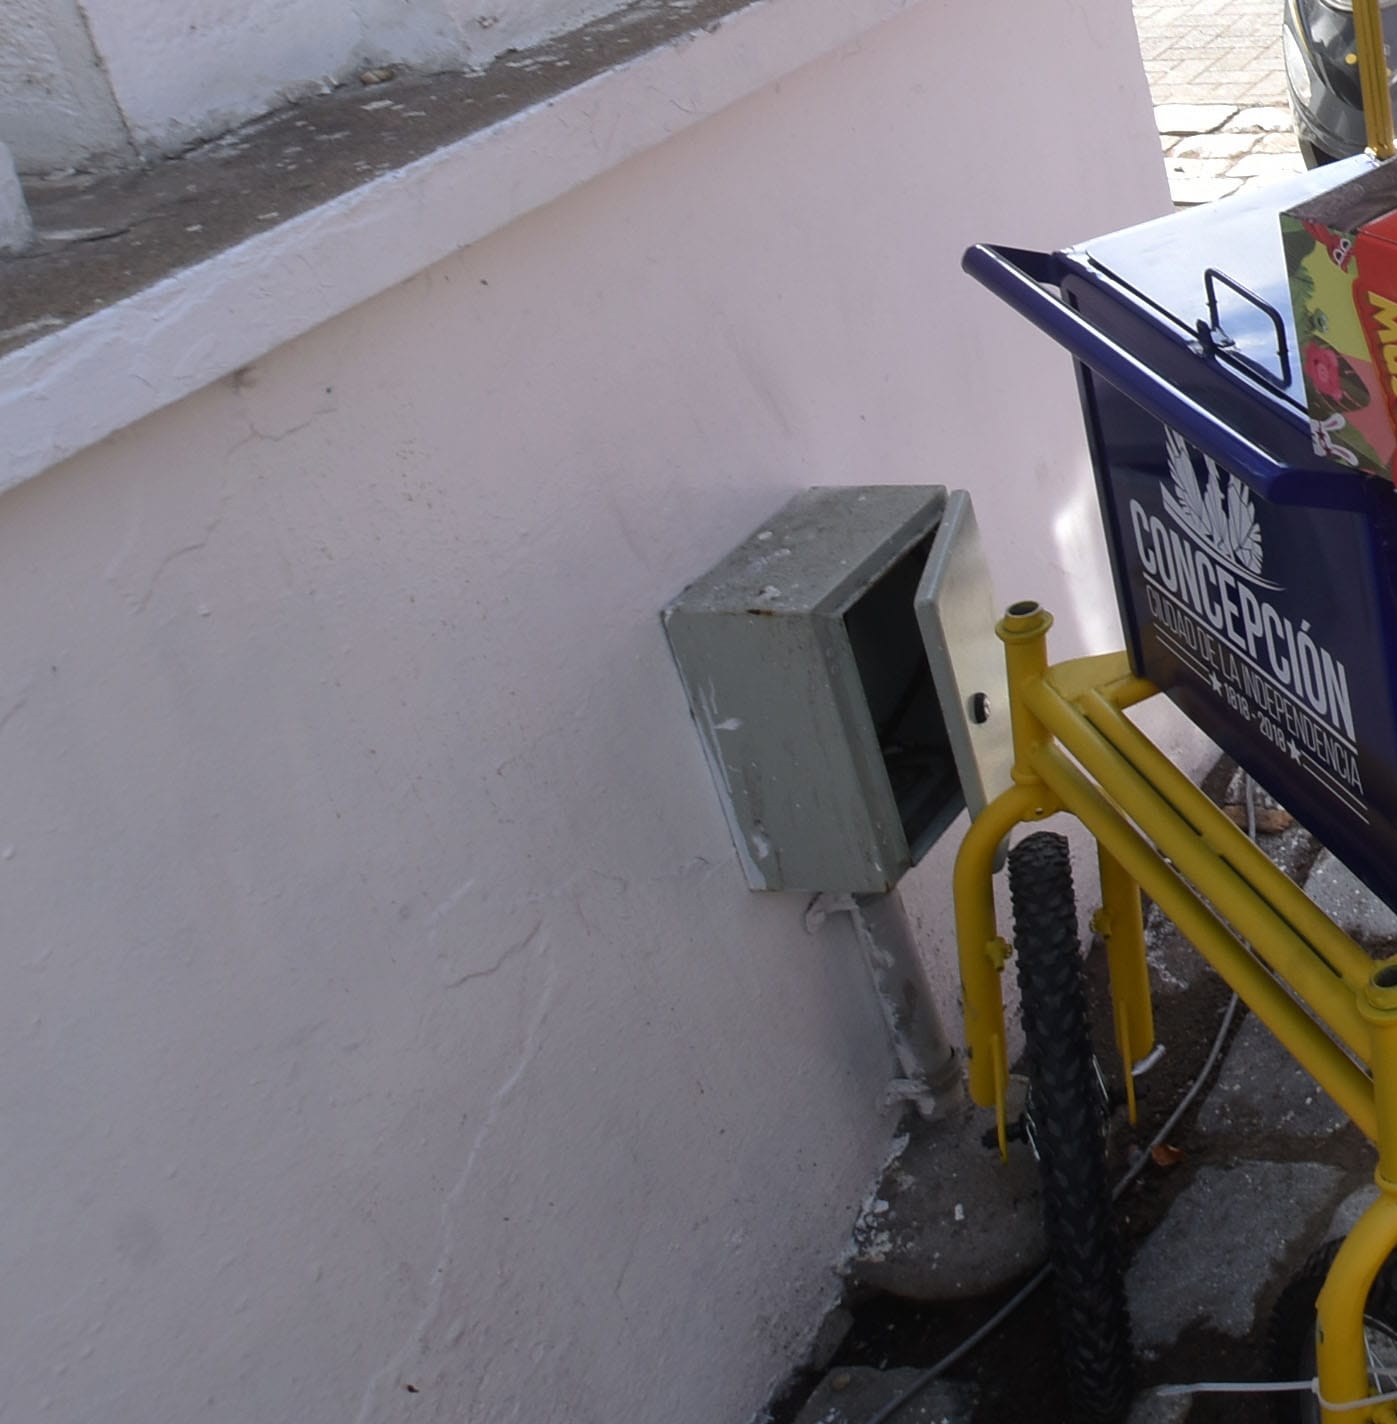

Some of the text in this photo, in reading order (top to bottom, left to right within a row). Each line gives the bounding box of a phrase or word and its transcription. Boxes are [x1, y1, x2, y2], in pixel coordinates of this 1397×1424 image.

[1129, 498, 1357, 743] CONCEPCIÓN
[1146, 585, 1364, 795] CIUDAD DE LA INDEPENDENCIA
[1224, 683, 1250, 721] 1818
[1260, 716, 1287, 753] 2018
